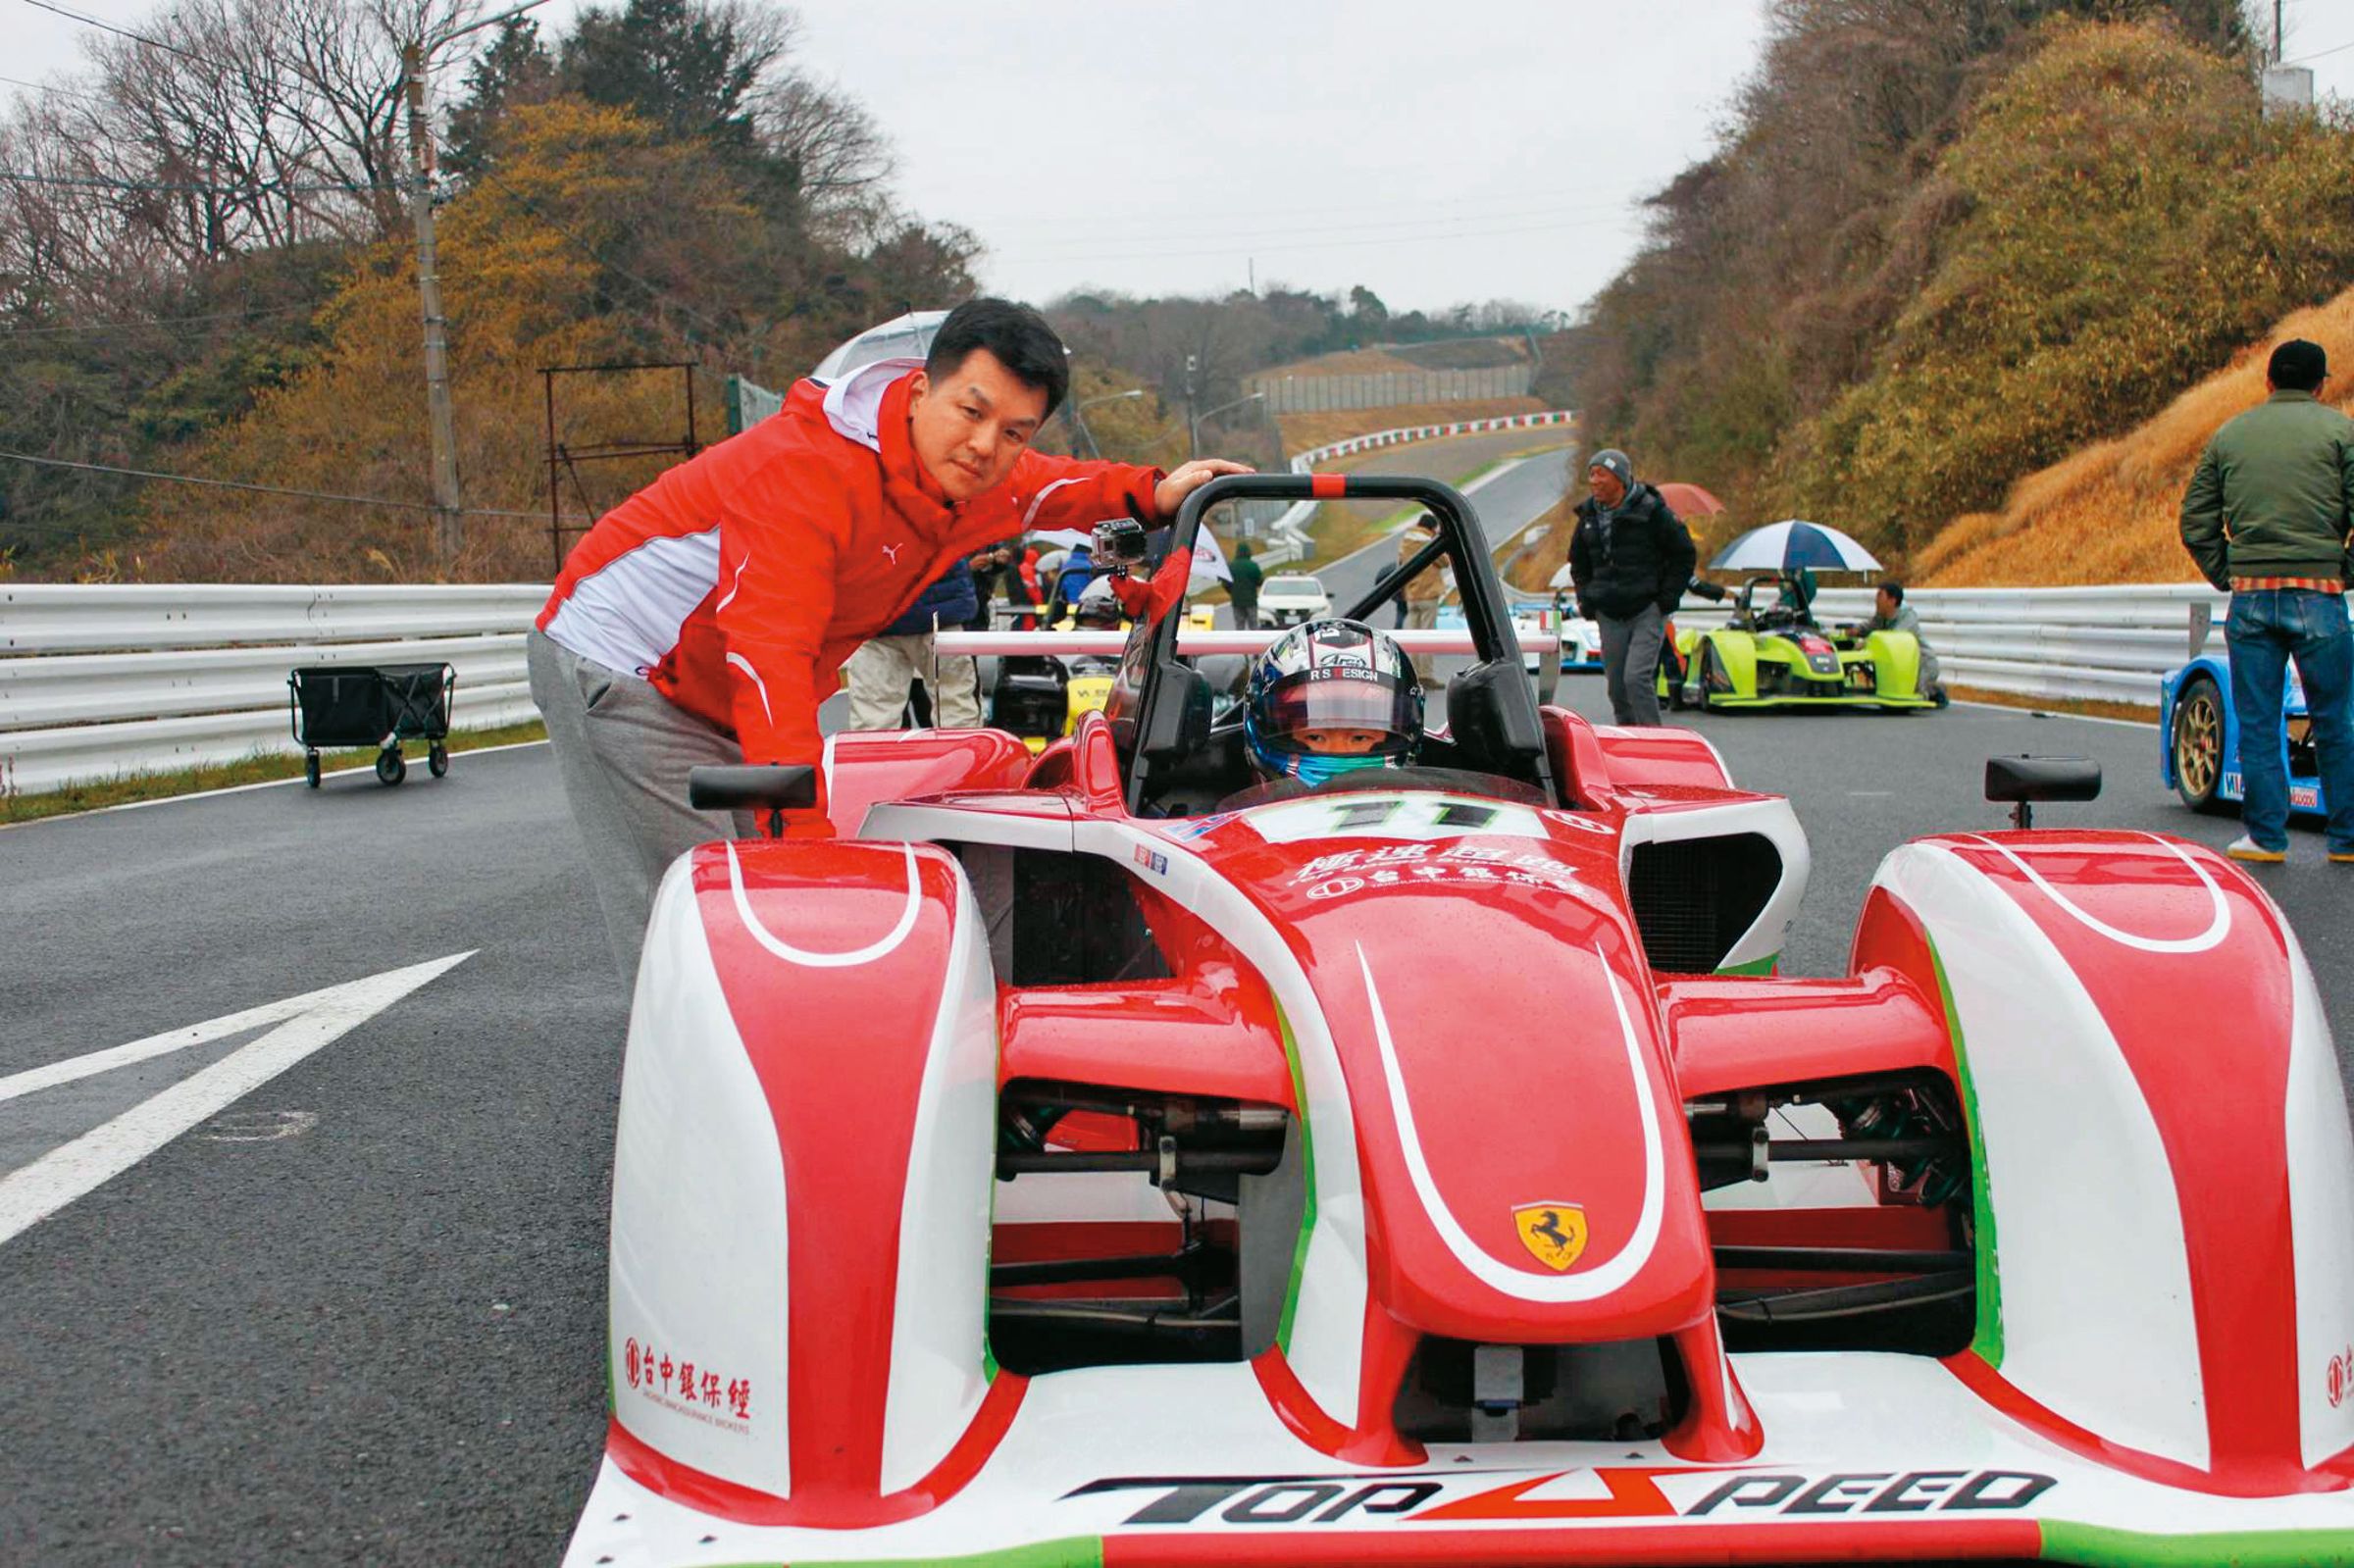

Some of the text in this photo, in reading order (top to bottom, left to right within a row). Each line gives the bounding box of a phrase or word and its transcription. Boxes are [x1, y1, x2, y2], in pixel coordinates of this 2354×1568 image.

[642, 1344, 751, 1421] 台中銀保經
[1053, 1471, 1444, 1525] TOP
